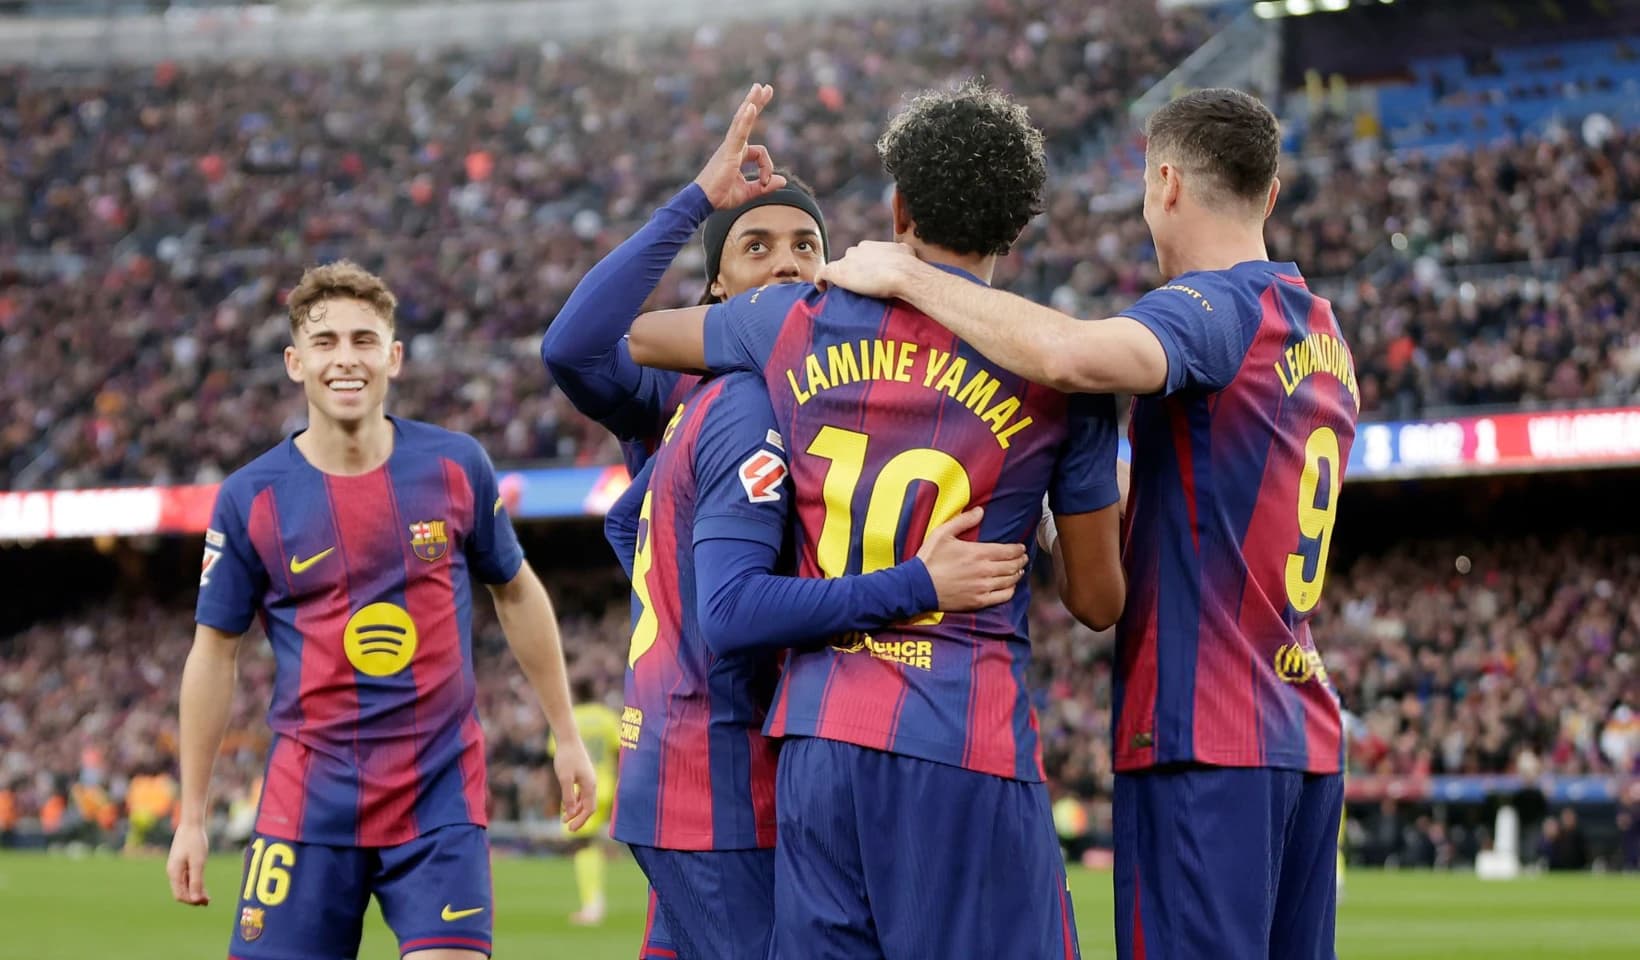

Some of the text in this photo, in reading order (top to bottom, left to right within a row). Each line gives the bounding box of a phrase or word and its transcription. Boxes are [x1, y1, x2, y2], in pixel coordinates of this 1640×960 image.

[786, 339, 1033, 449] LAMINE YAMAL
[1273, 332, 1360, 415] LEWANDOWS
[806, 425, 971, 625] 10
[1285, 426, 1339, 612] 9
[243, 838, 295, 906] 16
